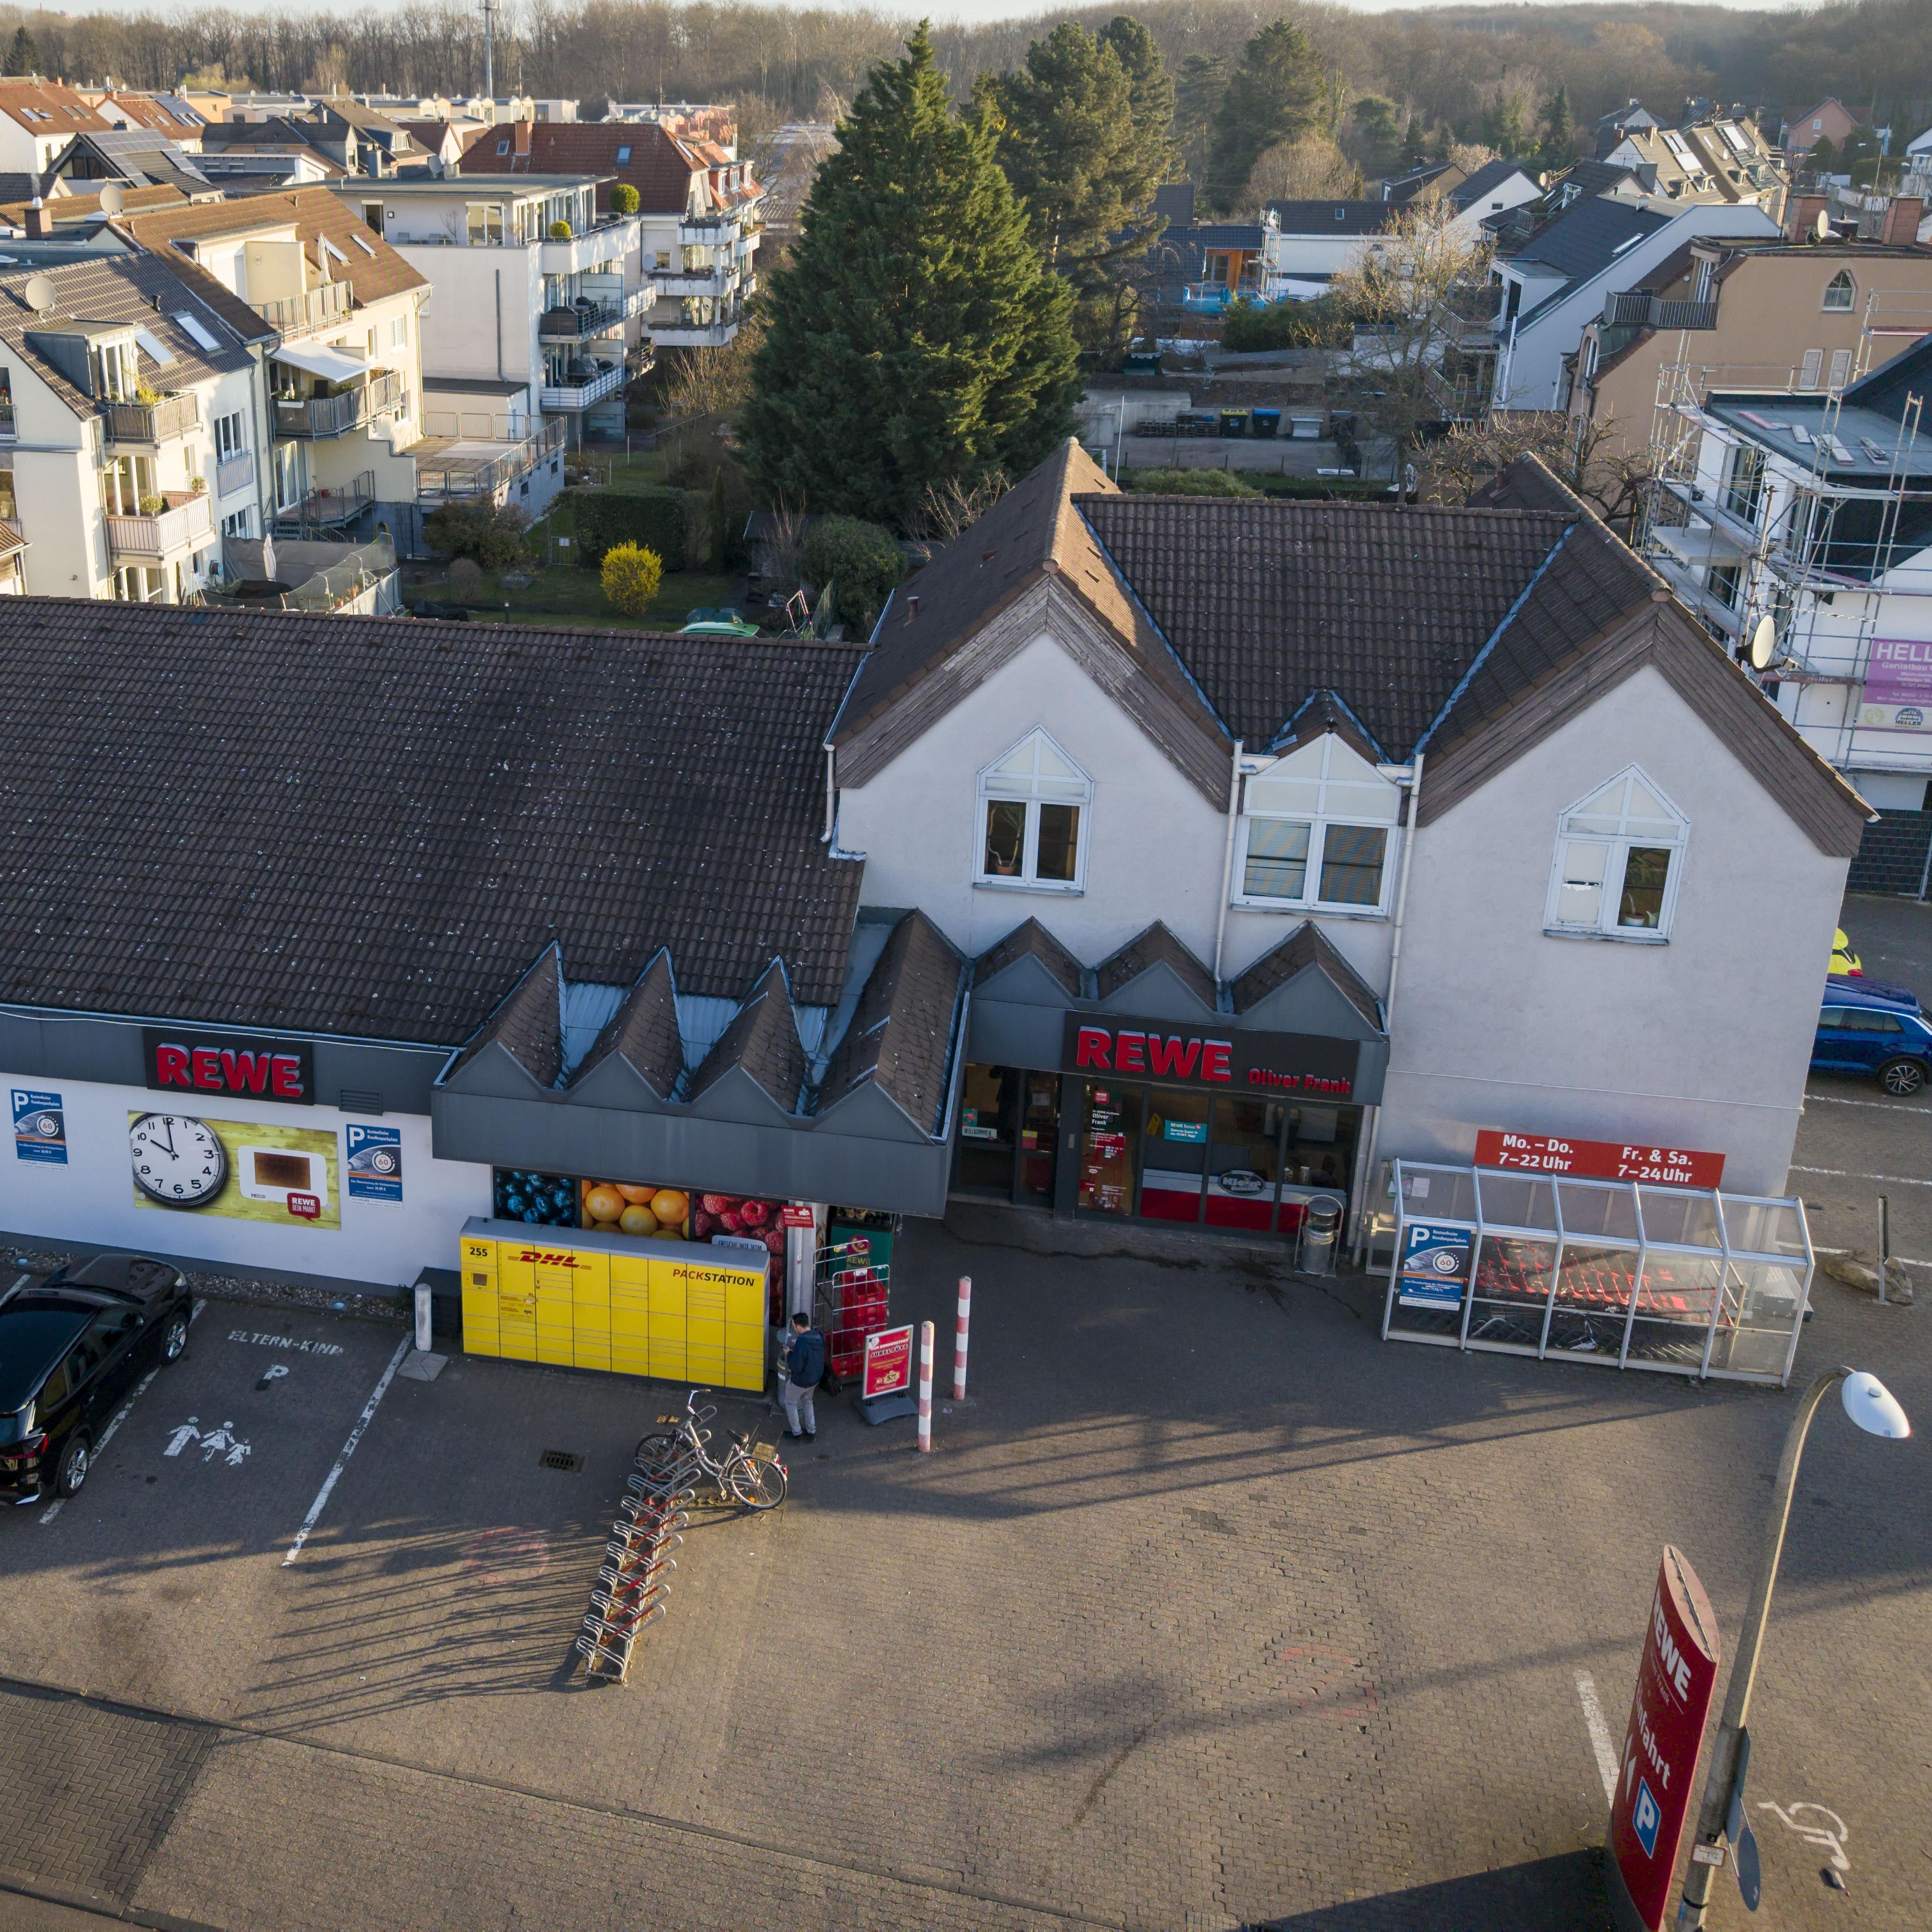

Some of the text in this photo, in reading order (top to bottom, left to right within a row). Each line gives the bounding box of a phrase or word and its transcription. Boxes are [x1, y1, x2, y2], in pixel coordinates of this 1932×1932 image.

[1882, 662, 1927, 671] Gerüstbau
[1077, 1027, 1232, 1082] REWE
[157, 1044, 303, 1097] REWE
[1249, 1068, 1351, 1093] Oliver Frank
[14, 1092, 29, 1112] P
[184, 1121, 188, 1129] 1
[137, 1132, 147, 1141] 10
[195, 1133, 205, 1141] 2
[349, 1127, 365, 1147] P
[1503, 1134, 1531, 1149] Mo.
[1547, 1140, 1574, 1154] Do.
[133, 1148, 142, 1157] 9
[204, 1150, 214, 1159] 3
[1622, 1147, 1693, 1166] Fr. & Sa.
[140, 1165, 151, 1174] 8
[202, 1166, 212, 1175] 4
[1543, 1157, 1572, 1171] Uhr
[1663, 1166, 1693, 1183] Uhr
[155, 1179, 163, 1189] 7
[173, 1184, 184, 1194] 6
[191, 1180, 202, 1189] 5
[292, 1197, 315, 1206] REWE
[1411, 1227, 1430, 1247] P
[469, 1246, 488, 1257] 255
[519, 1251, 580, 1268] DHL
[673, 1269, 755, 1287] PACKSTATION
[227, 1329, 345, 1356] ELTERN-KIND
[871, 1344, 908, 1357] JUBELTÜTE
[1637, 1789, 1655, 1830] P
